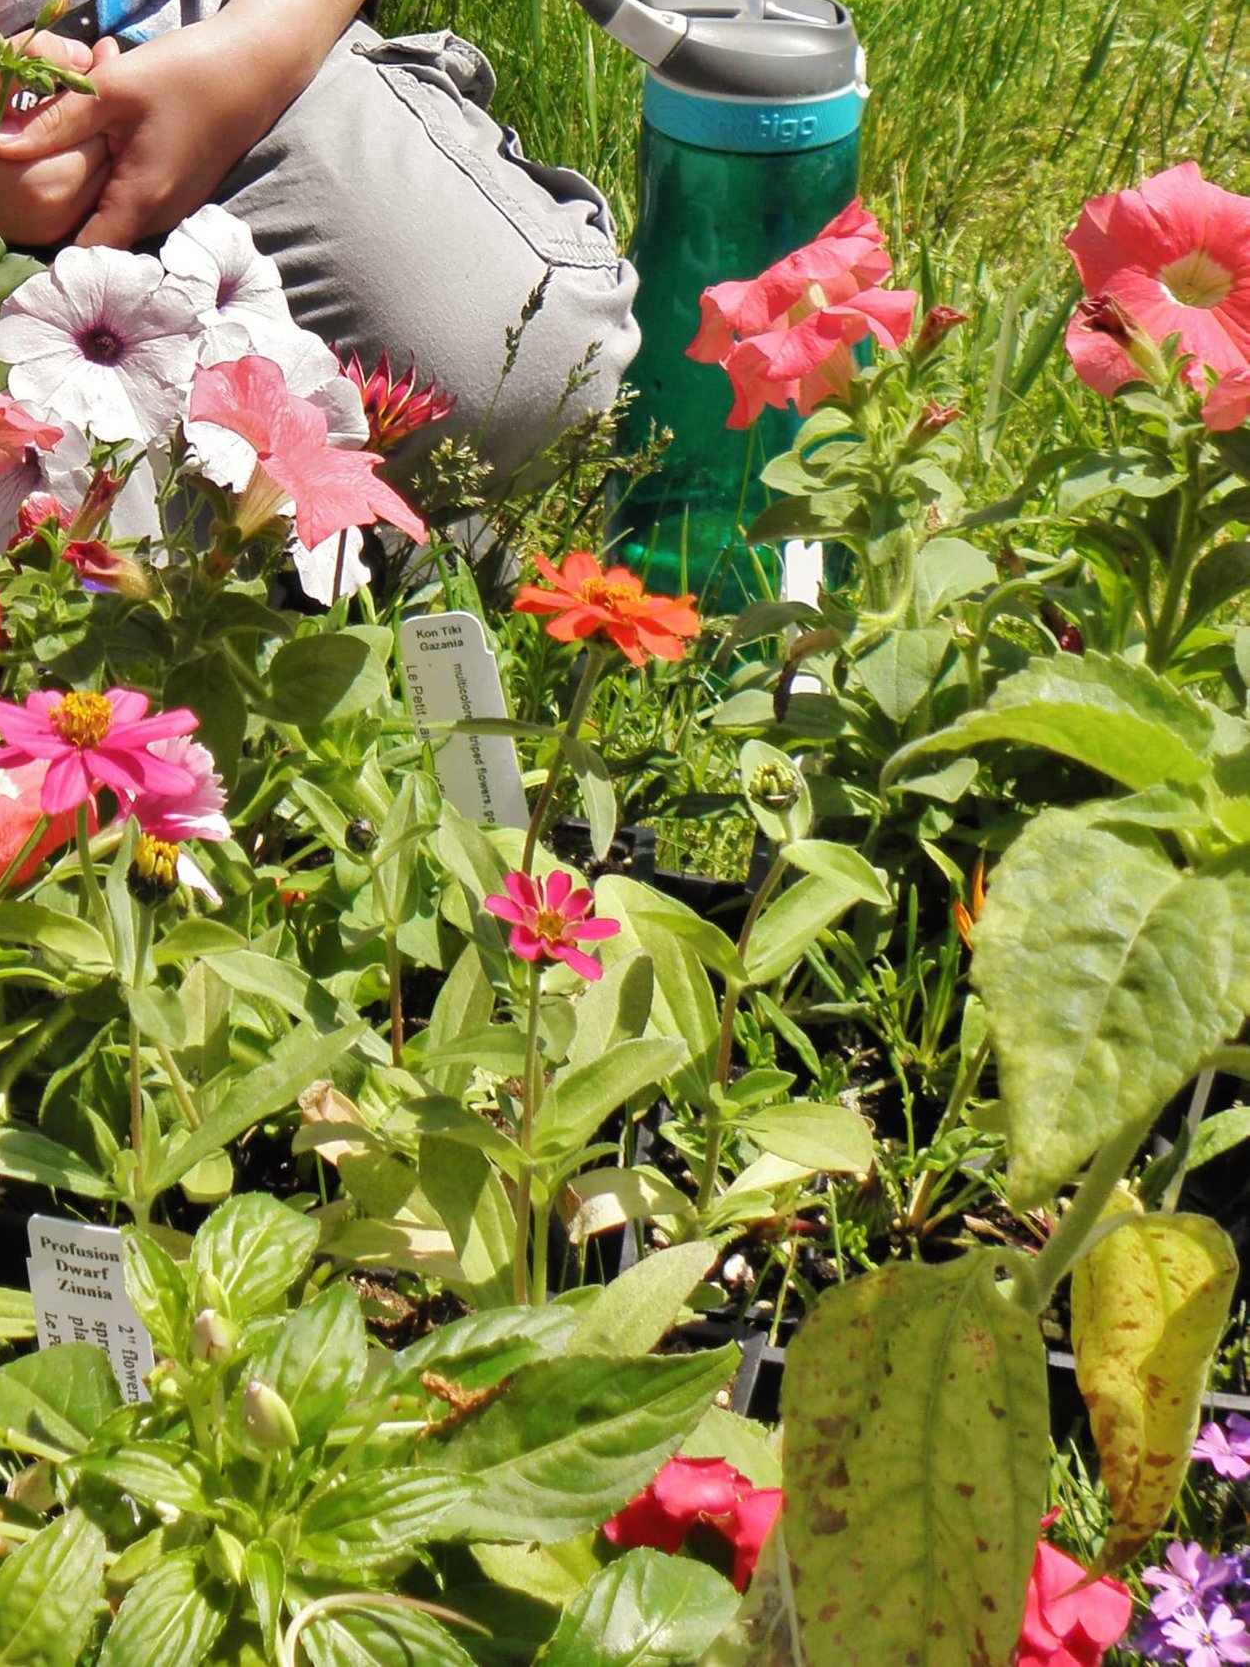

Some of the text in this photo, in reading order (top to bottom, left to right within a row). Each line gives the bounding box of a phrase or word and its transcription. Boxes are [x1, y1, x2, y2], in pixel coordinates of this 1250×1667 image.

[416, 624, 462, 639] Kon Tiki
[420, 640, 464, 652] Gazania
[406, 665, 418, 681] Le
[411, 686, 428, 716] Petit
[453, 663, 473, 720] multicolore
[469, 735, 485, 765] triped
[40, 1235, 120, 1263] Profusion
[55, 1258, 109, 1280] Dwarf
[58, 1278, 113, 1301] Zinnia
[44, 1311, 58, 1329] Le
